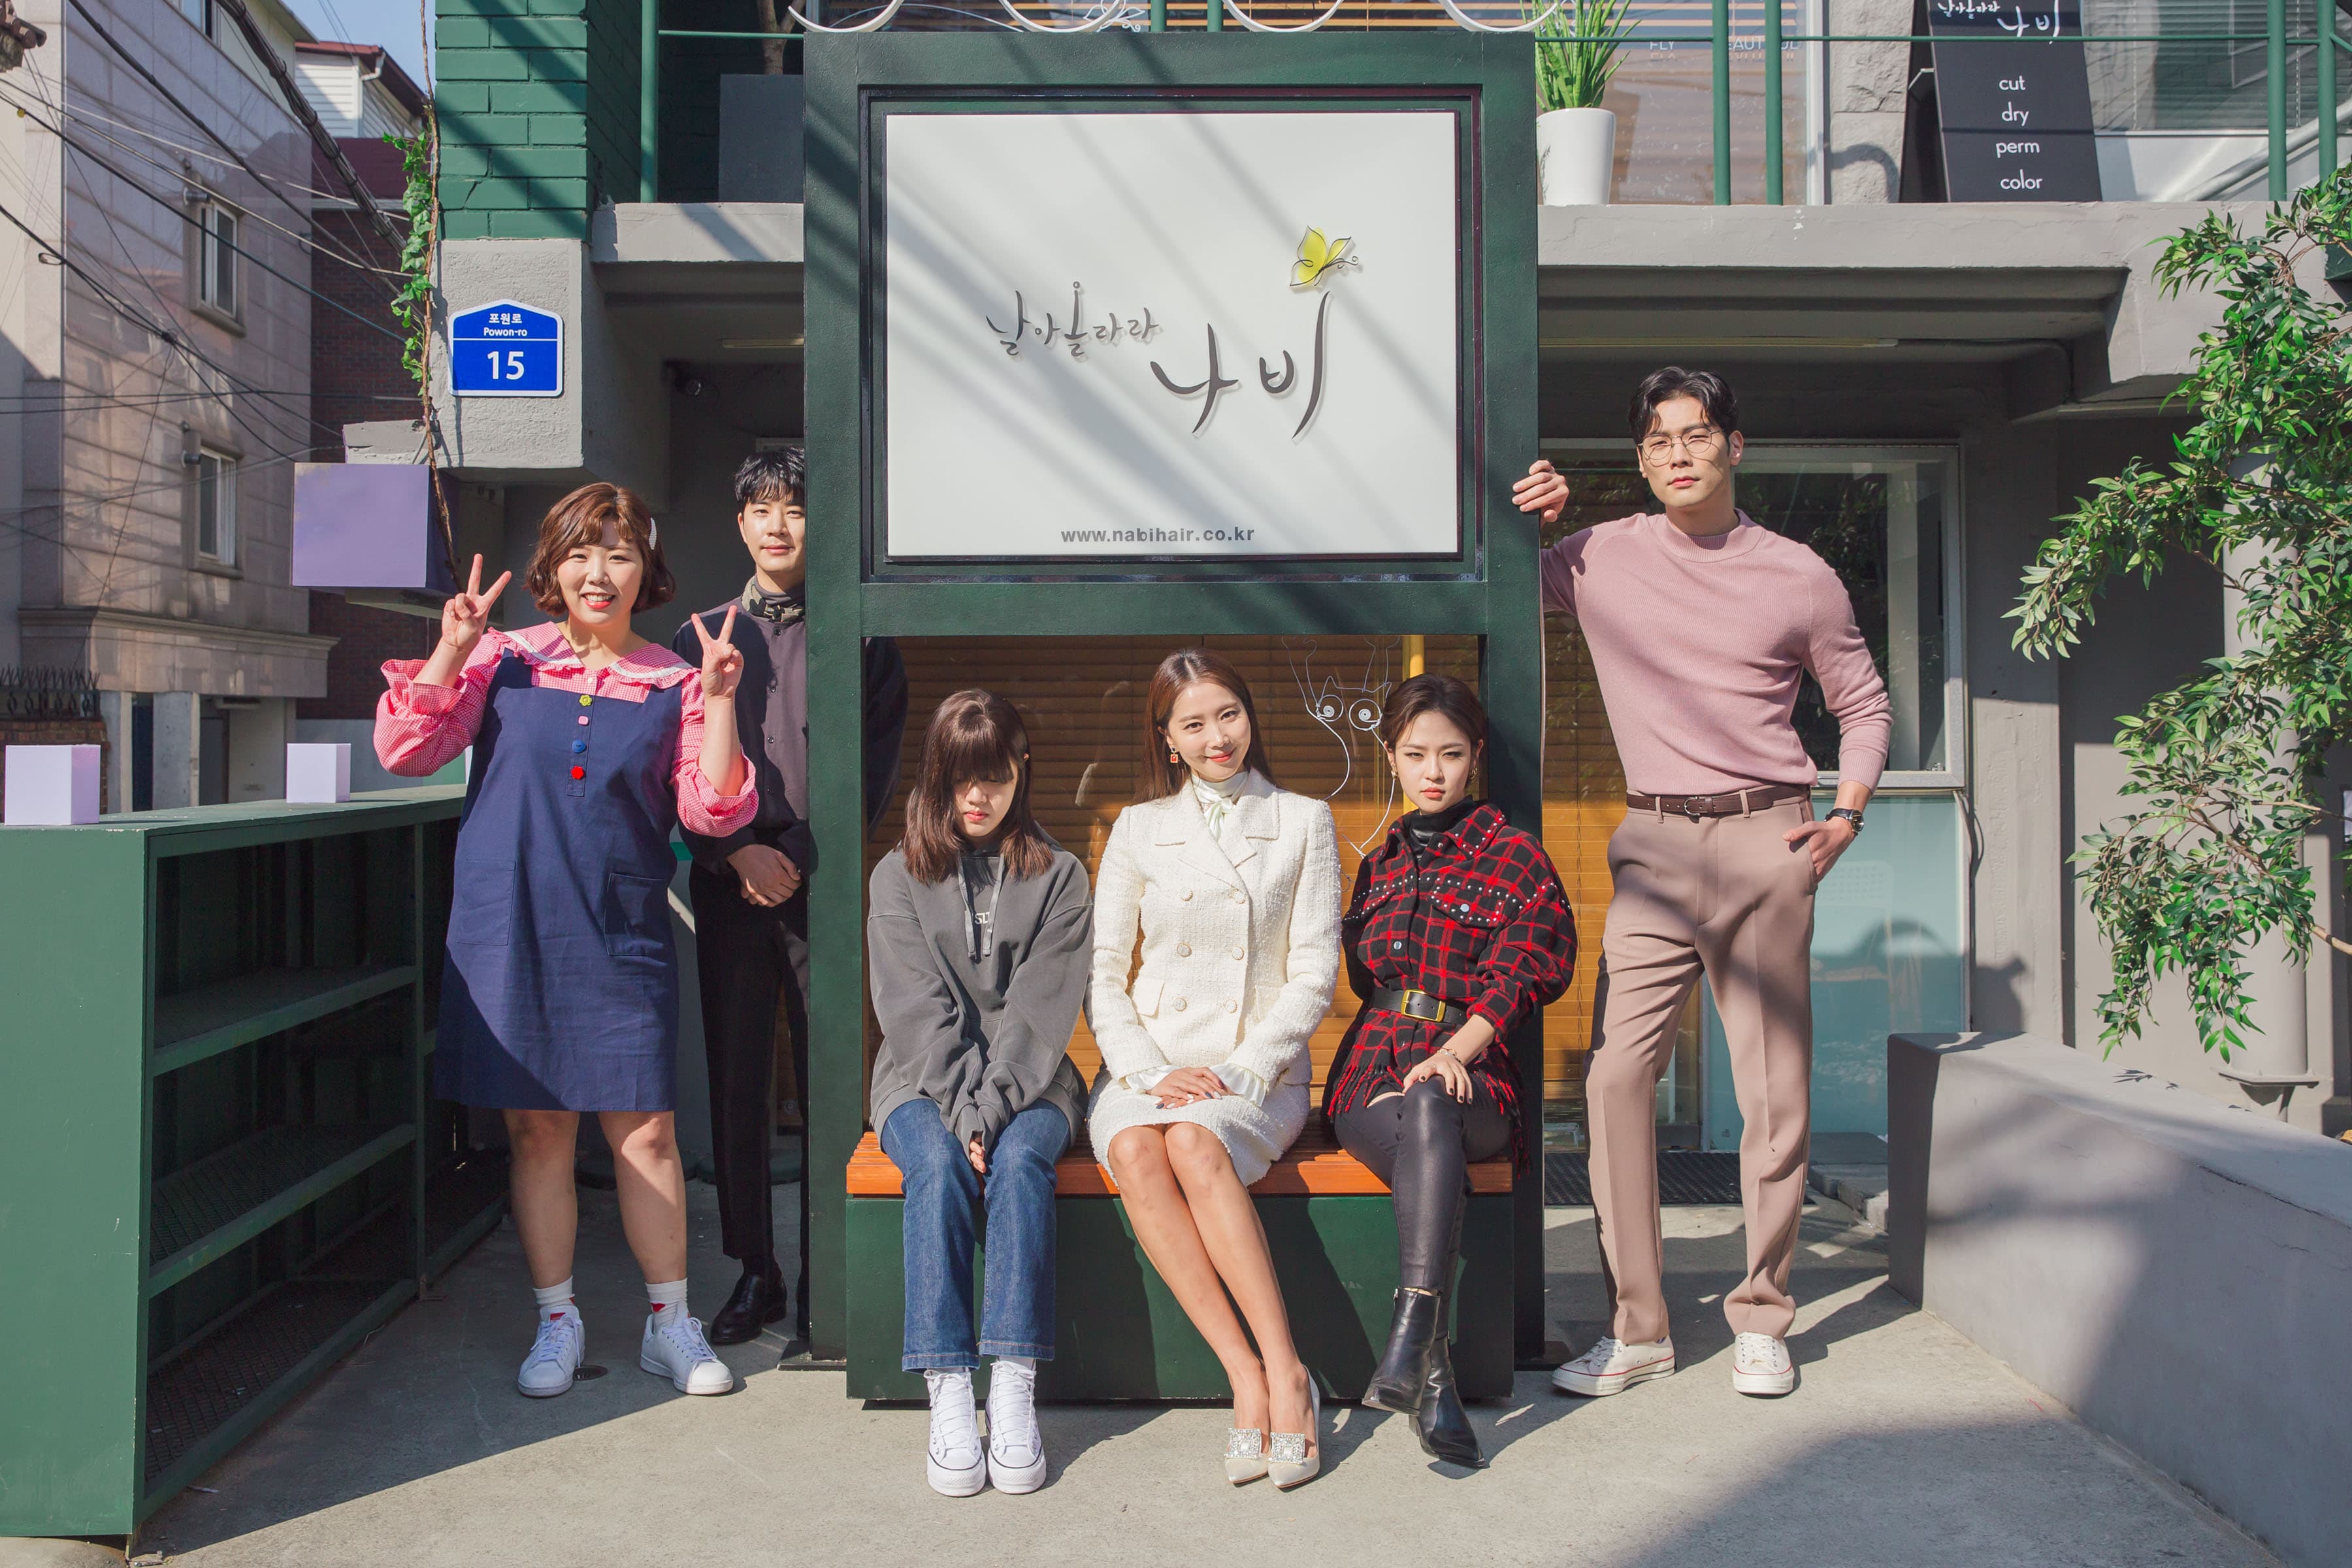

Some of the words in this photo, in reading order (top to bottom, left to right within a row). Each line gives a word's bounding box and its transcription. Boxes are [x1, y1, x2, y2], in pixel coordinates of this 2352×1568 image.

[1999, 75, 2026, 91] cut
[2001, 101, 2029, 127] dry
[1995, 141, 2040, 159] perm
[2000, 169, 2043, 189] color
[488, 312, 523, 325] 포원로
[483, 327, 528, 336] Powon-ro
[487, 351, 525, 380] 15
[985, 281, 1160, 357] 날아올라라
[1150, 290, 1331, 440] 나비
[1060, 527, 1255, 543] www.nabihair.co.kr
